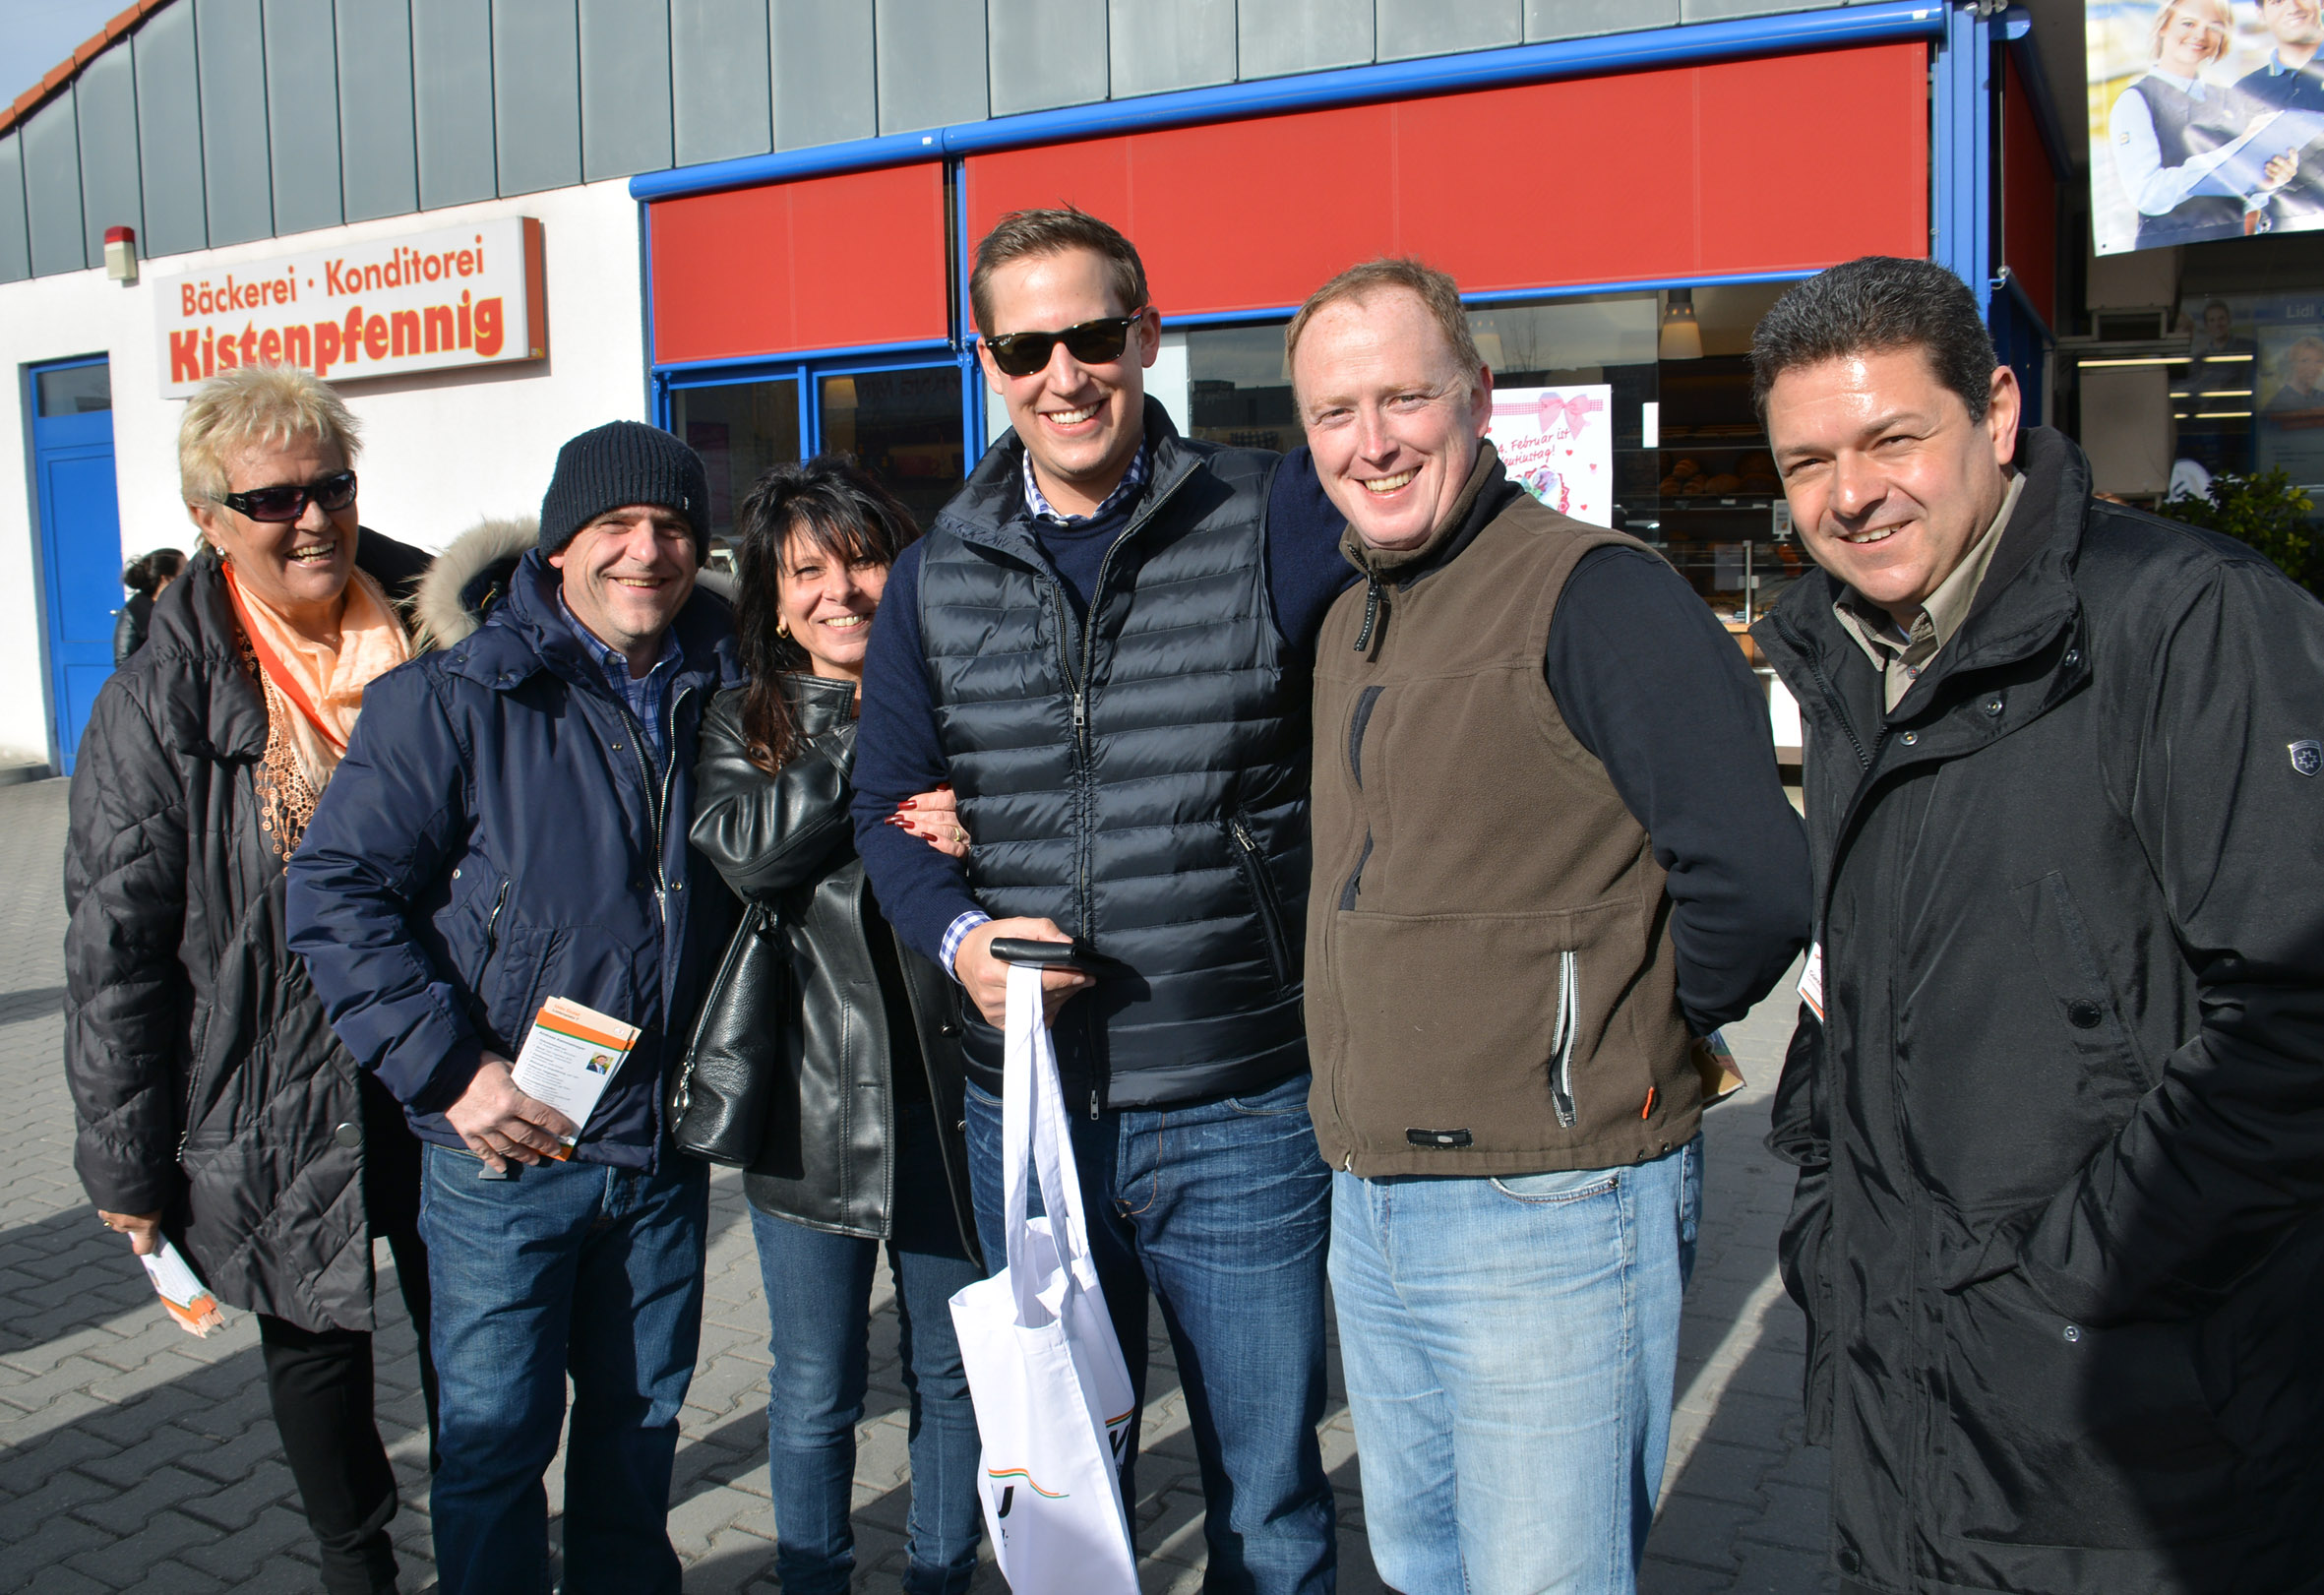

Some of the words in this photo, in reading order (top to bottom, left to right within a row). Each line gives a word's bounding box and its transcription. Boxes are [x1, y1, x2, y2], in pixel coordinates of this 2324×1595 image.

[181, 266, 296, 317] Bäckerei
[326, 234, 484, 297] Konditorei
[169, 288, 505, 382] Kistenpfennig
[2287, 303, 2314, 319] Lidl
[1497, 444, 1507, 454] 4.
[1511, 434, 1555, 452] Februar
[1557, 427, 1571, 440] ist
